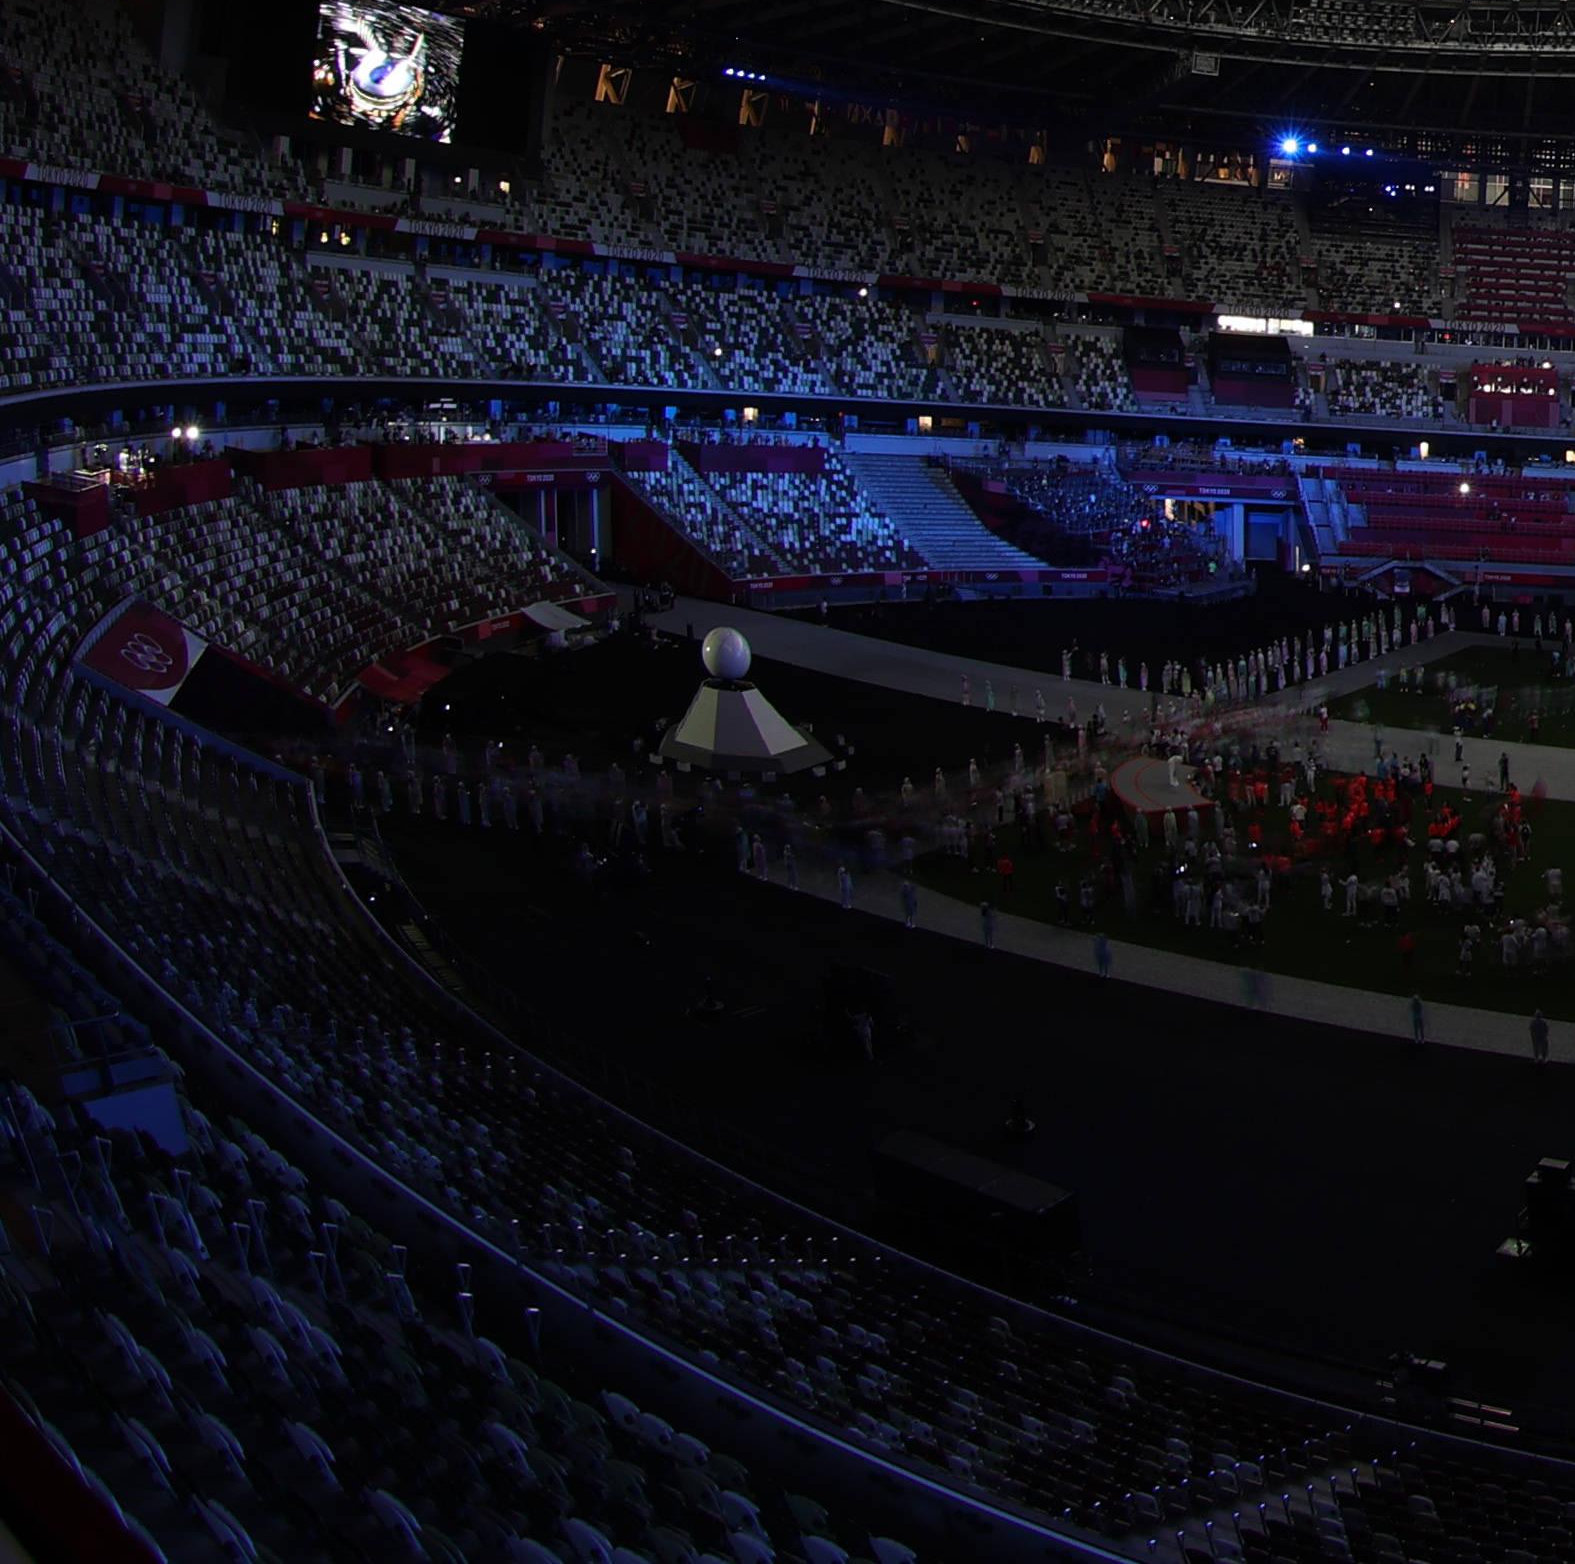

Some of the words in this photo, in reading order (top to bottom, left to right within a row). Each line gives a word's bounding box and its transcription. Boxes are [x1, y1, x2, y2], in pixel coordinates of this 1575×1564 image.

[1017, 288, 1047, 300] TOKYO
[1048, 289, 1074, 300] 2020
[1445, 320, 1476, 332] TOKYO
[1478, 321, 1505, 332] 2020
